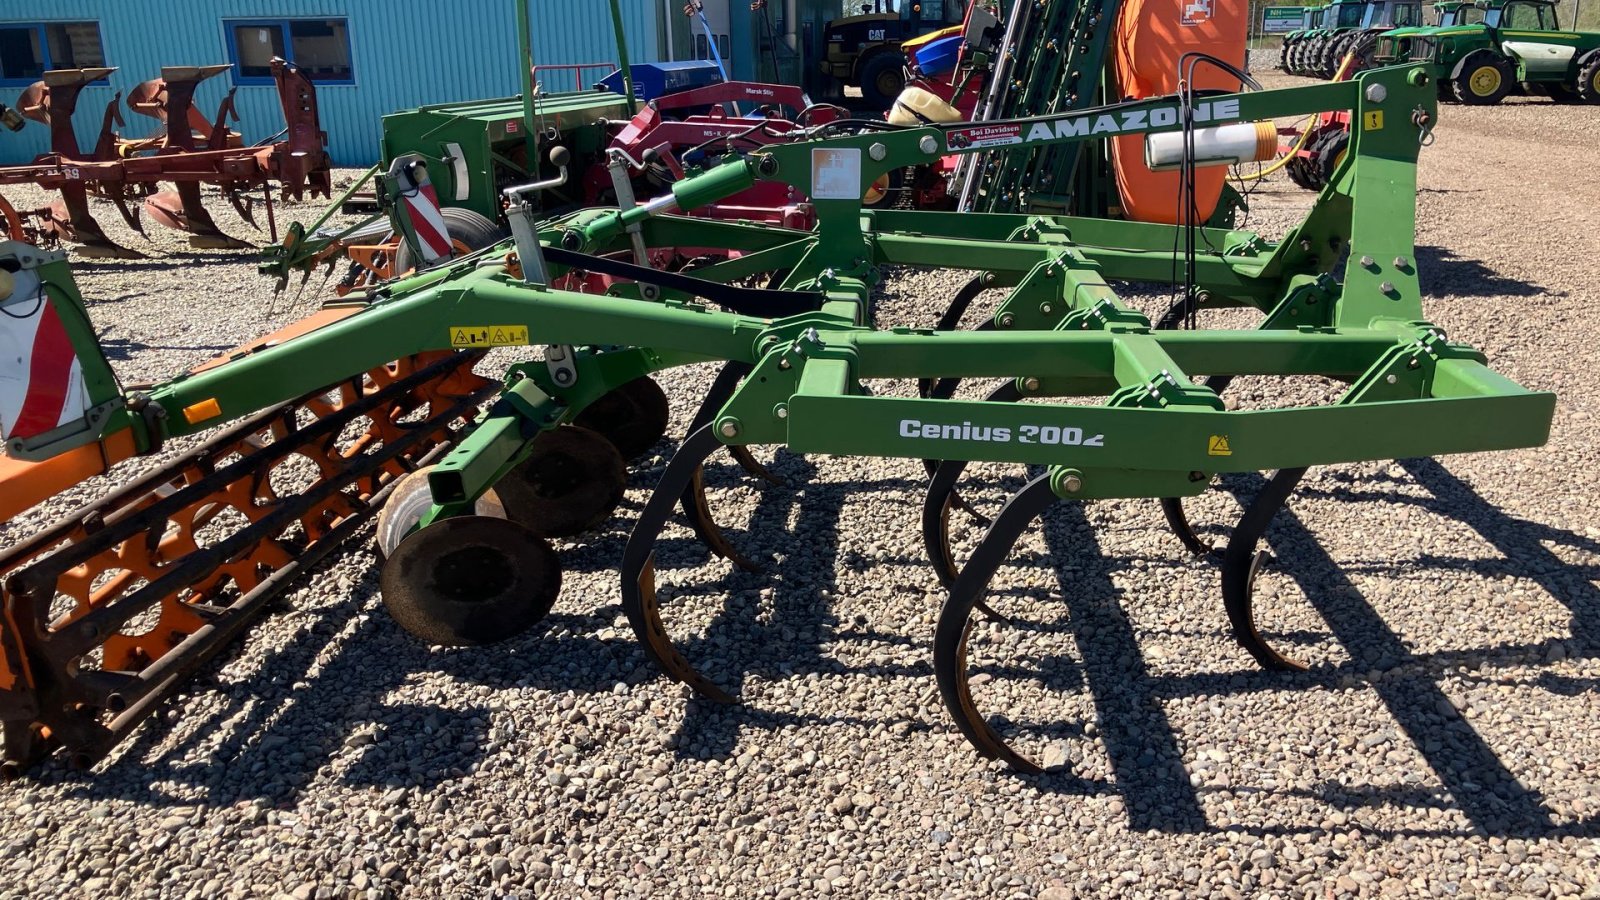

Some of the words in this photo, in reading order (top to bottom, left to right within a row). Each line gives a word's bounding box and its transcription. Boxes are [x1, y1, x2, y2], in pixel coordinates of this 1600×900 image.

[868, 29, 886, 41] CAT
[1027, 98, 1240, 142] AMAZONE
[984, 125, 1020, 136] Davidsen
[899, 419, 1012, 443] Cenius
